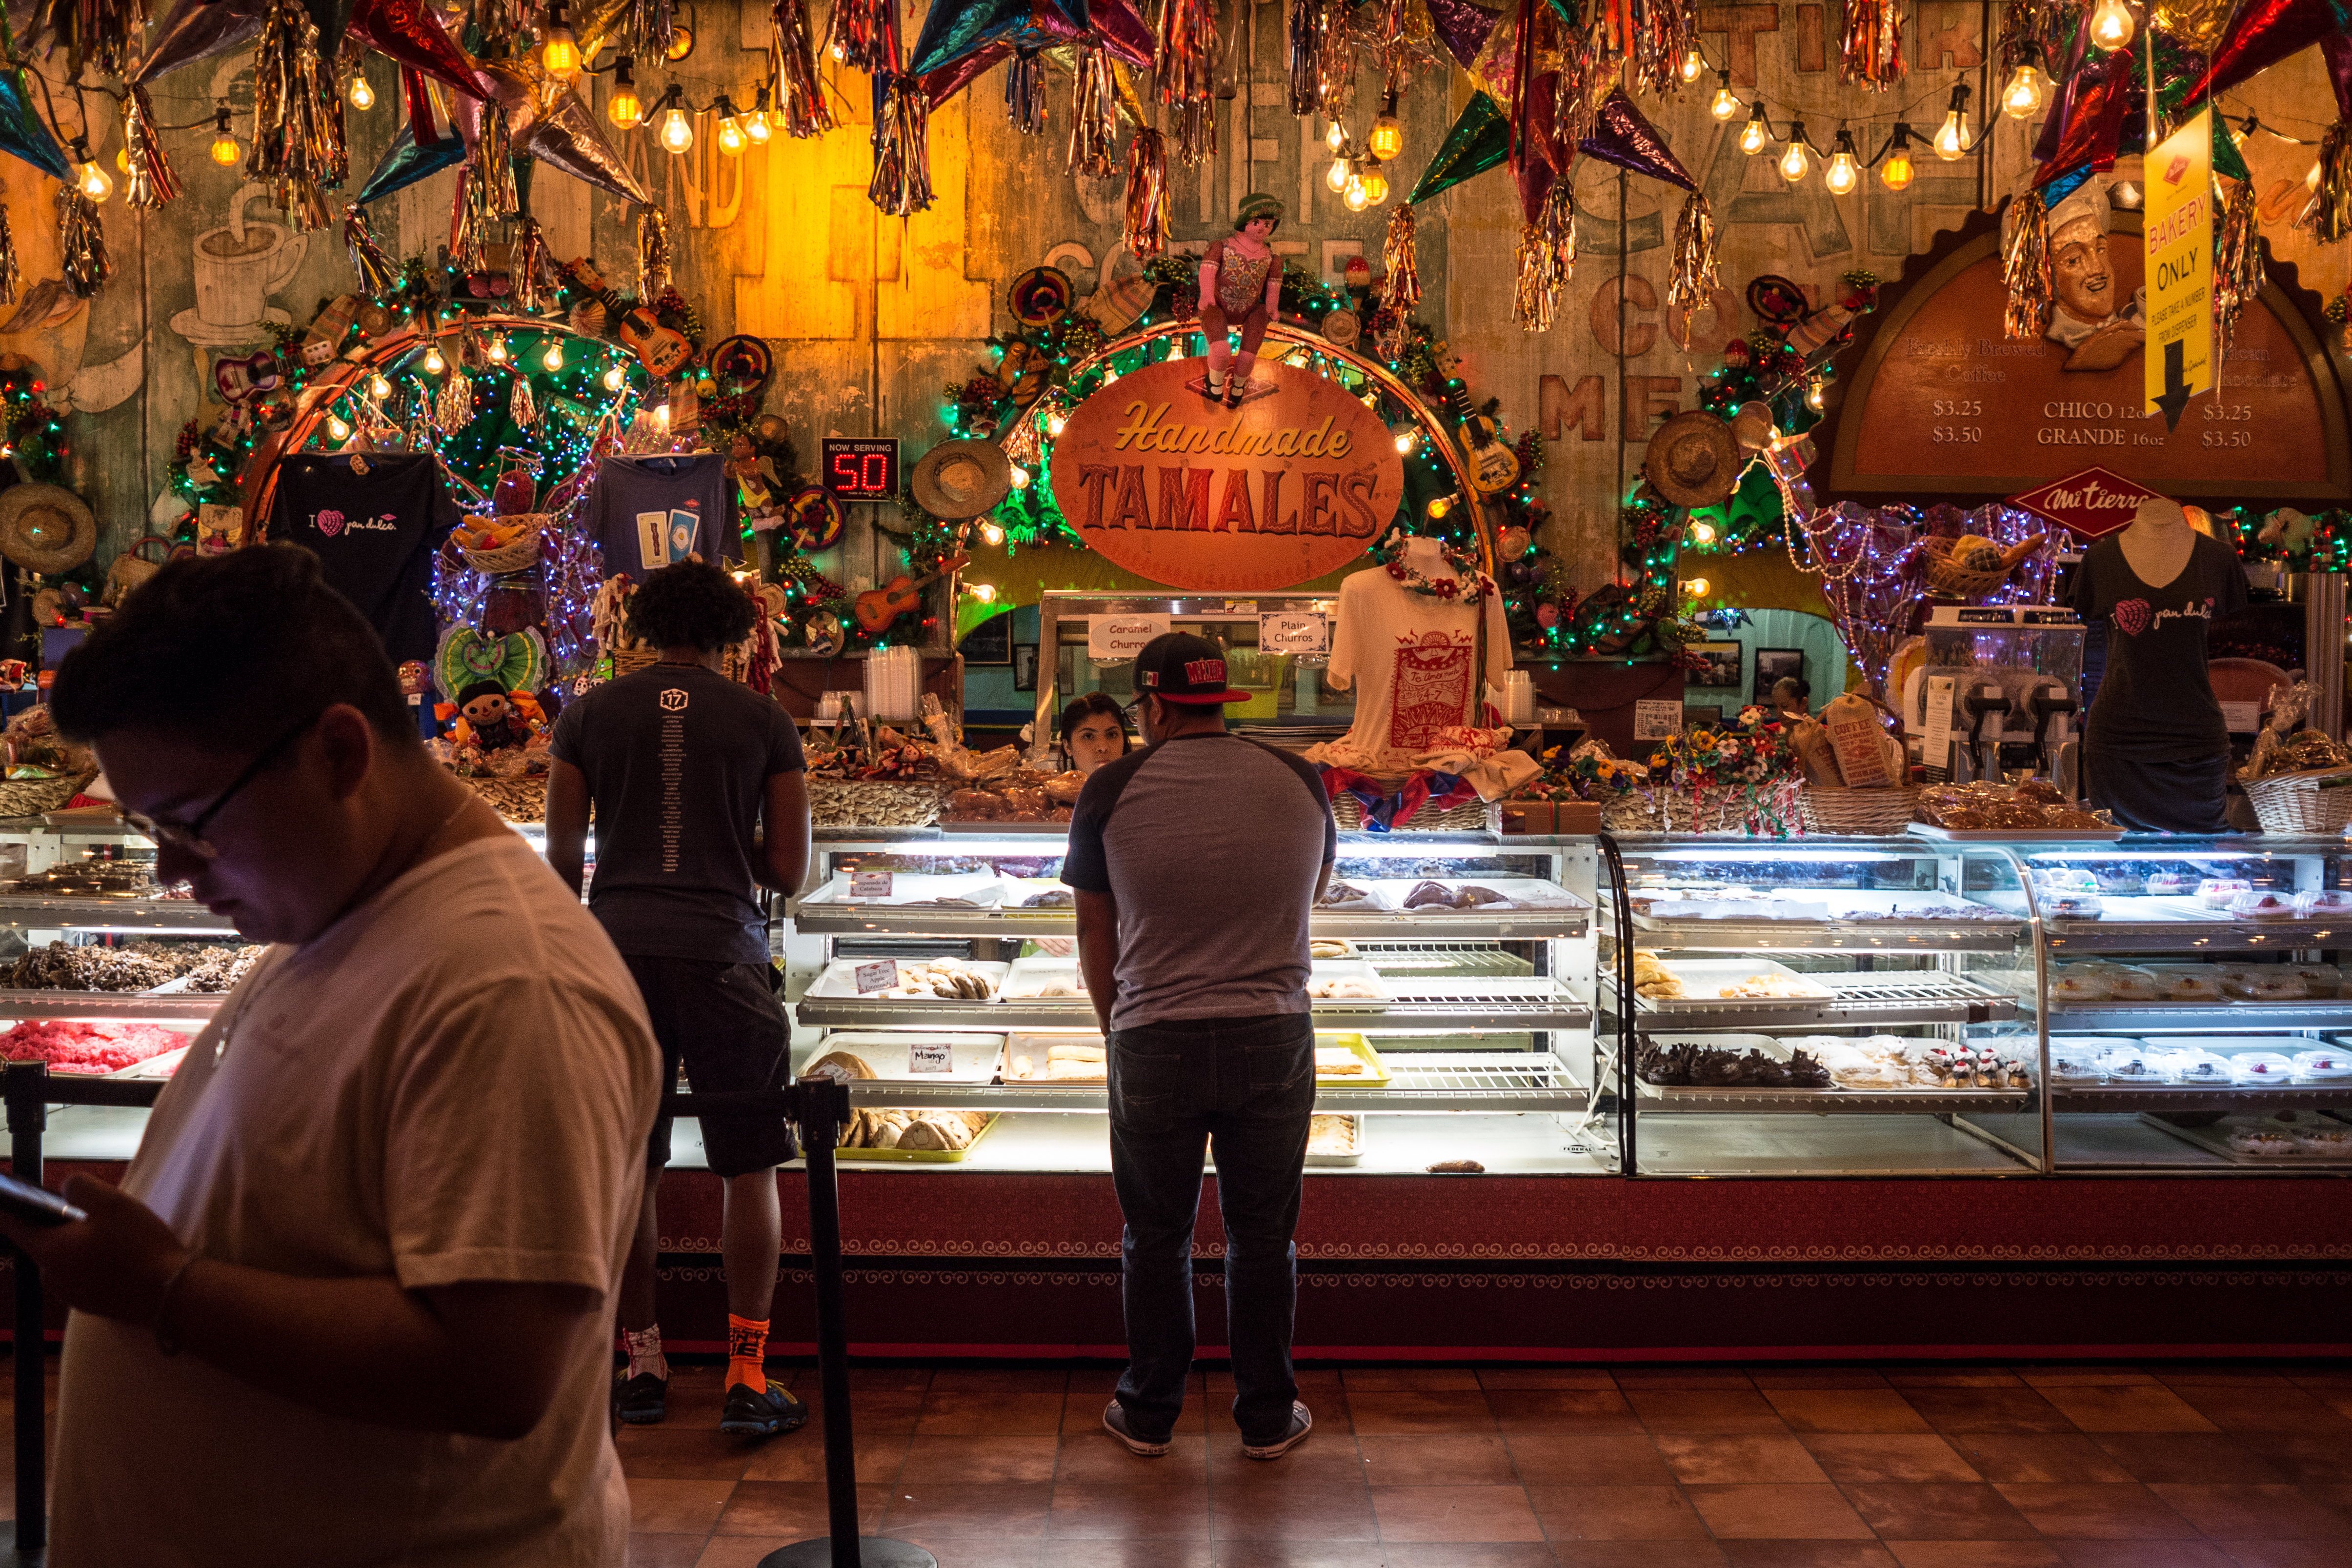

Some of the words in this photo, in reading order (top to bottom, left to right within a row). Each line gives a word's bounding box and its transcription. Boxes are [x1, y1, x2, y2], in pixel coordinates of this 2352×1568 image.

[2149, 190, 2208, 257] BAKERY
[2157, 247, 2198, 291] ONLY
[1905, 337, 1972, 359] Freshly
[1978, 338, 2047, 357] Brewed
[2220, 344, 2271, 361] xican
[1945, 364, 2006, 382] Coffee
[2222, 369, 2297, 387] hocolate
[1932, 399, 1982, 418] $3.25
[2044, 401, 2113, 419] CHICO
[2203, 404, 2251, 422] $3.25
[1115, 400, 1353, 459] Handmade
[1932, 425, 1982, 444] $3.50
[2037, 428, 2126, 445] GRANDE
[2132, 433, 2165, 446] 16oz
[2202, 430, 2251, 447] $3.50
[834, 454, 887, 490] 50
[1079, 463, 1378, 537] TAMALES
[309, 514, 315, 528] I
[344, 521, 365, 536] pan
[1281, 621, 1306, 630] Plain
[2153, 608, 2182, 630] pan
[1109, 624, 1152, 634] Caramel
[1274, 633, 1313, 642] Churros
[1110, 640, 1148, 649] Churro
[1411, 671, 1421, 683] Te
[667, 694, 682, 705] 17
[1834, 718, 1871, 736] COFFEE
[915, 1050, 945, 1064] Mango
